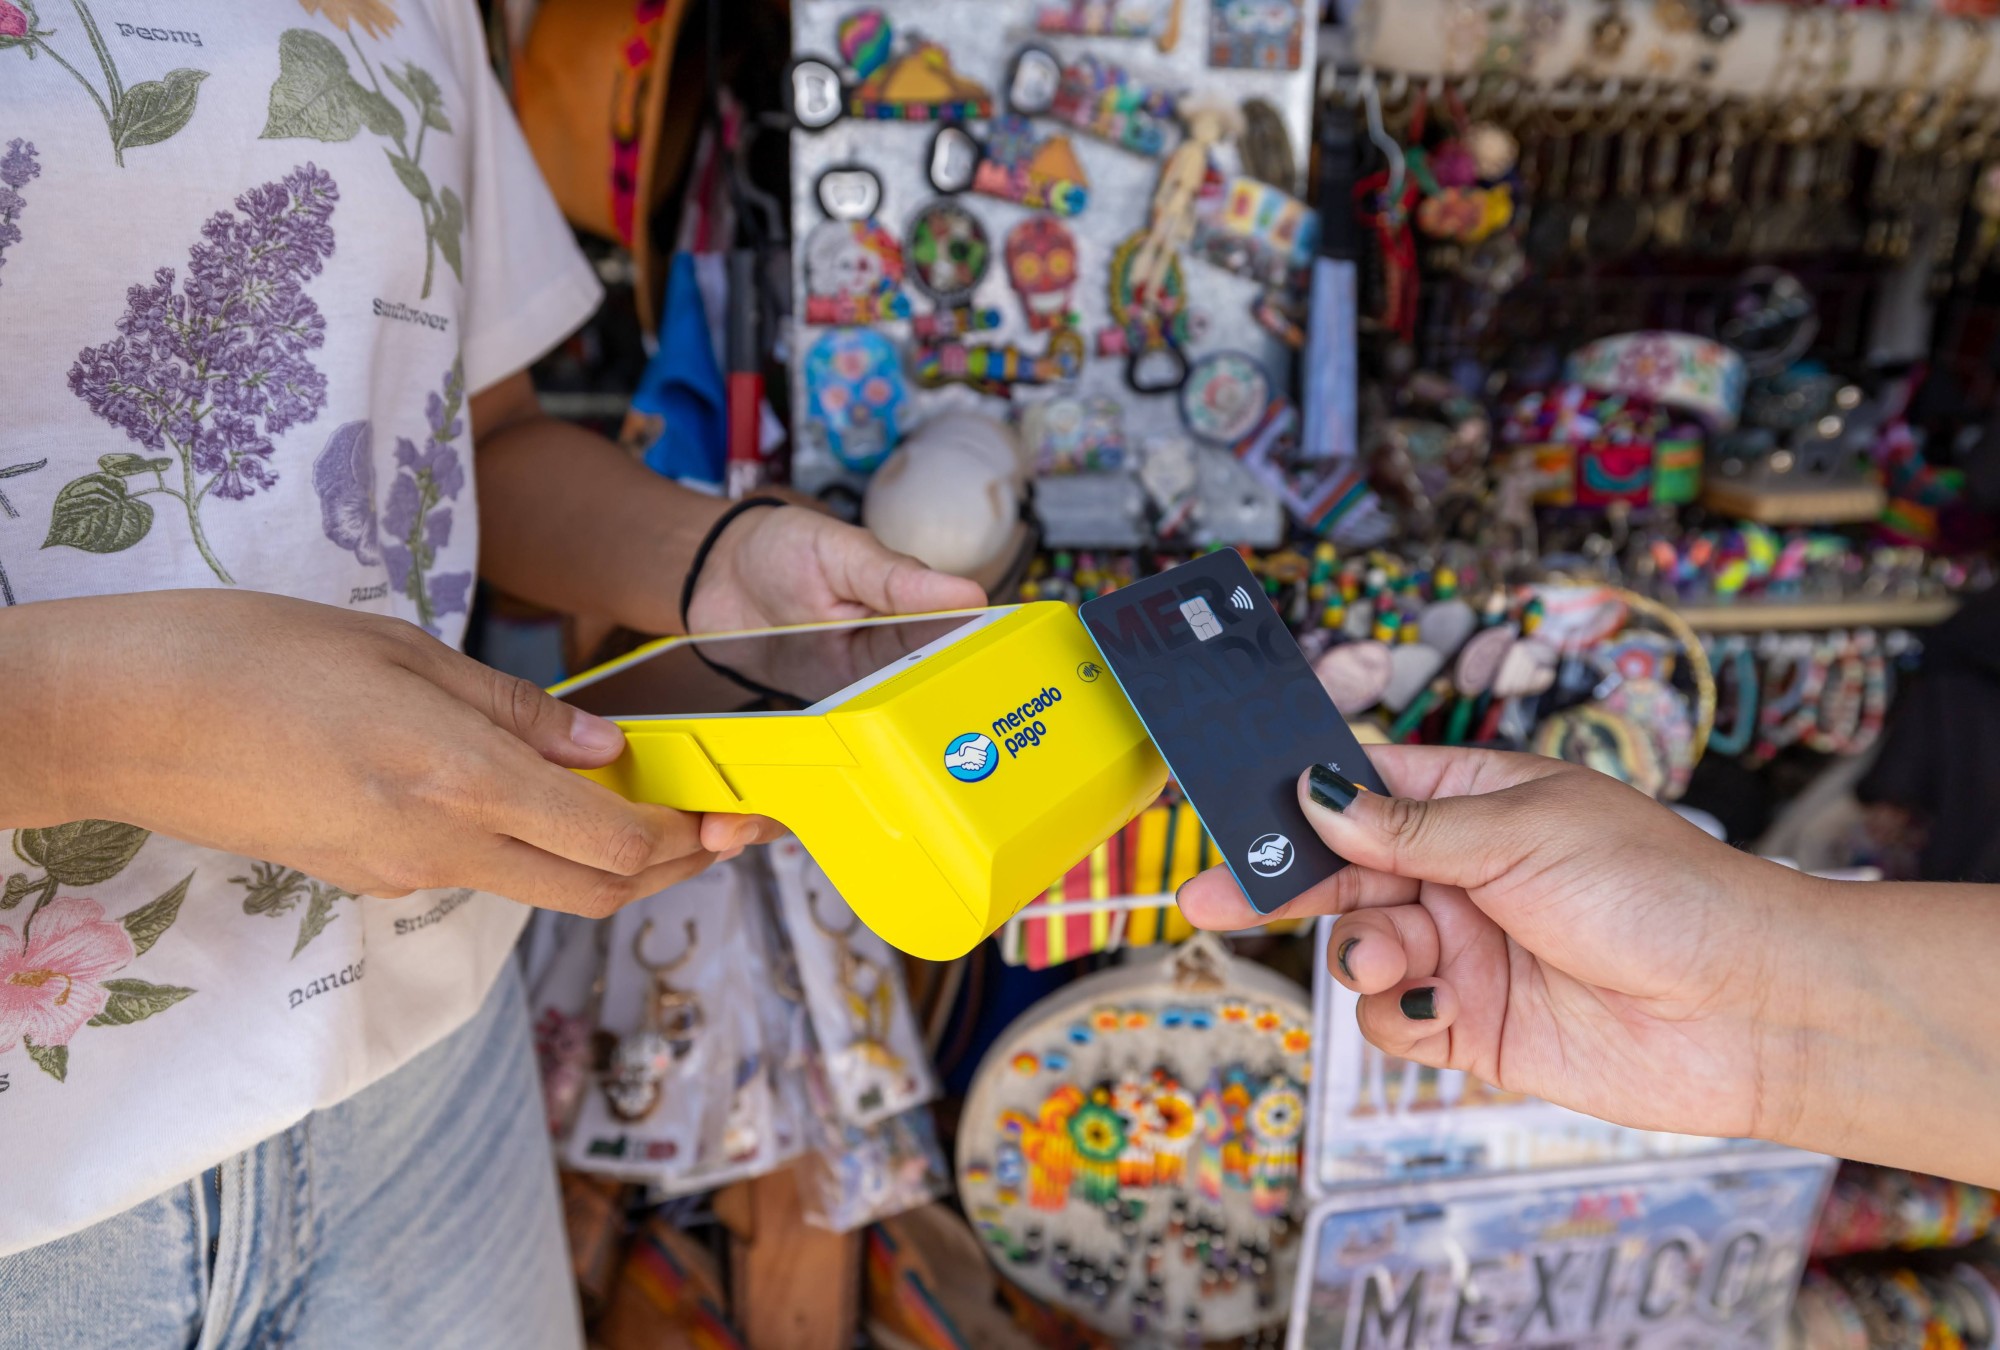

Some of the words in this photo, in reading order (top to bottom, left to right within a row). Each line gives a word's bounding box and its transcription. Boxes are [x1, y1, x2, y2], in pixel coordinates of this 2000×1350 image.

[992, 687, 1062, 737] mercado
[1004, 721, 1047, 759] pago
[1344, 1223, 1770, 1350] MEXICO
